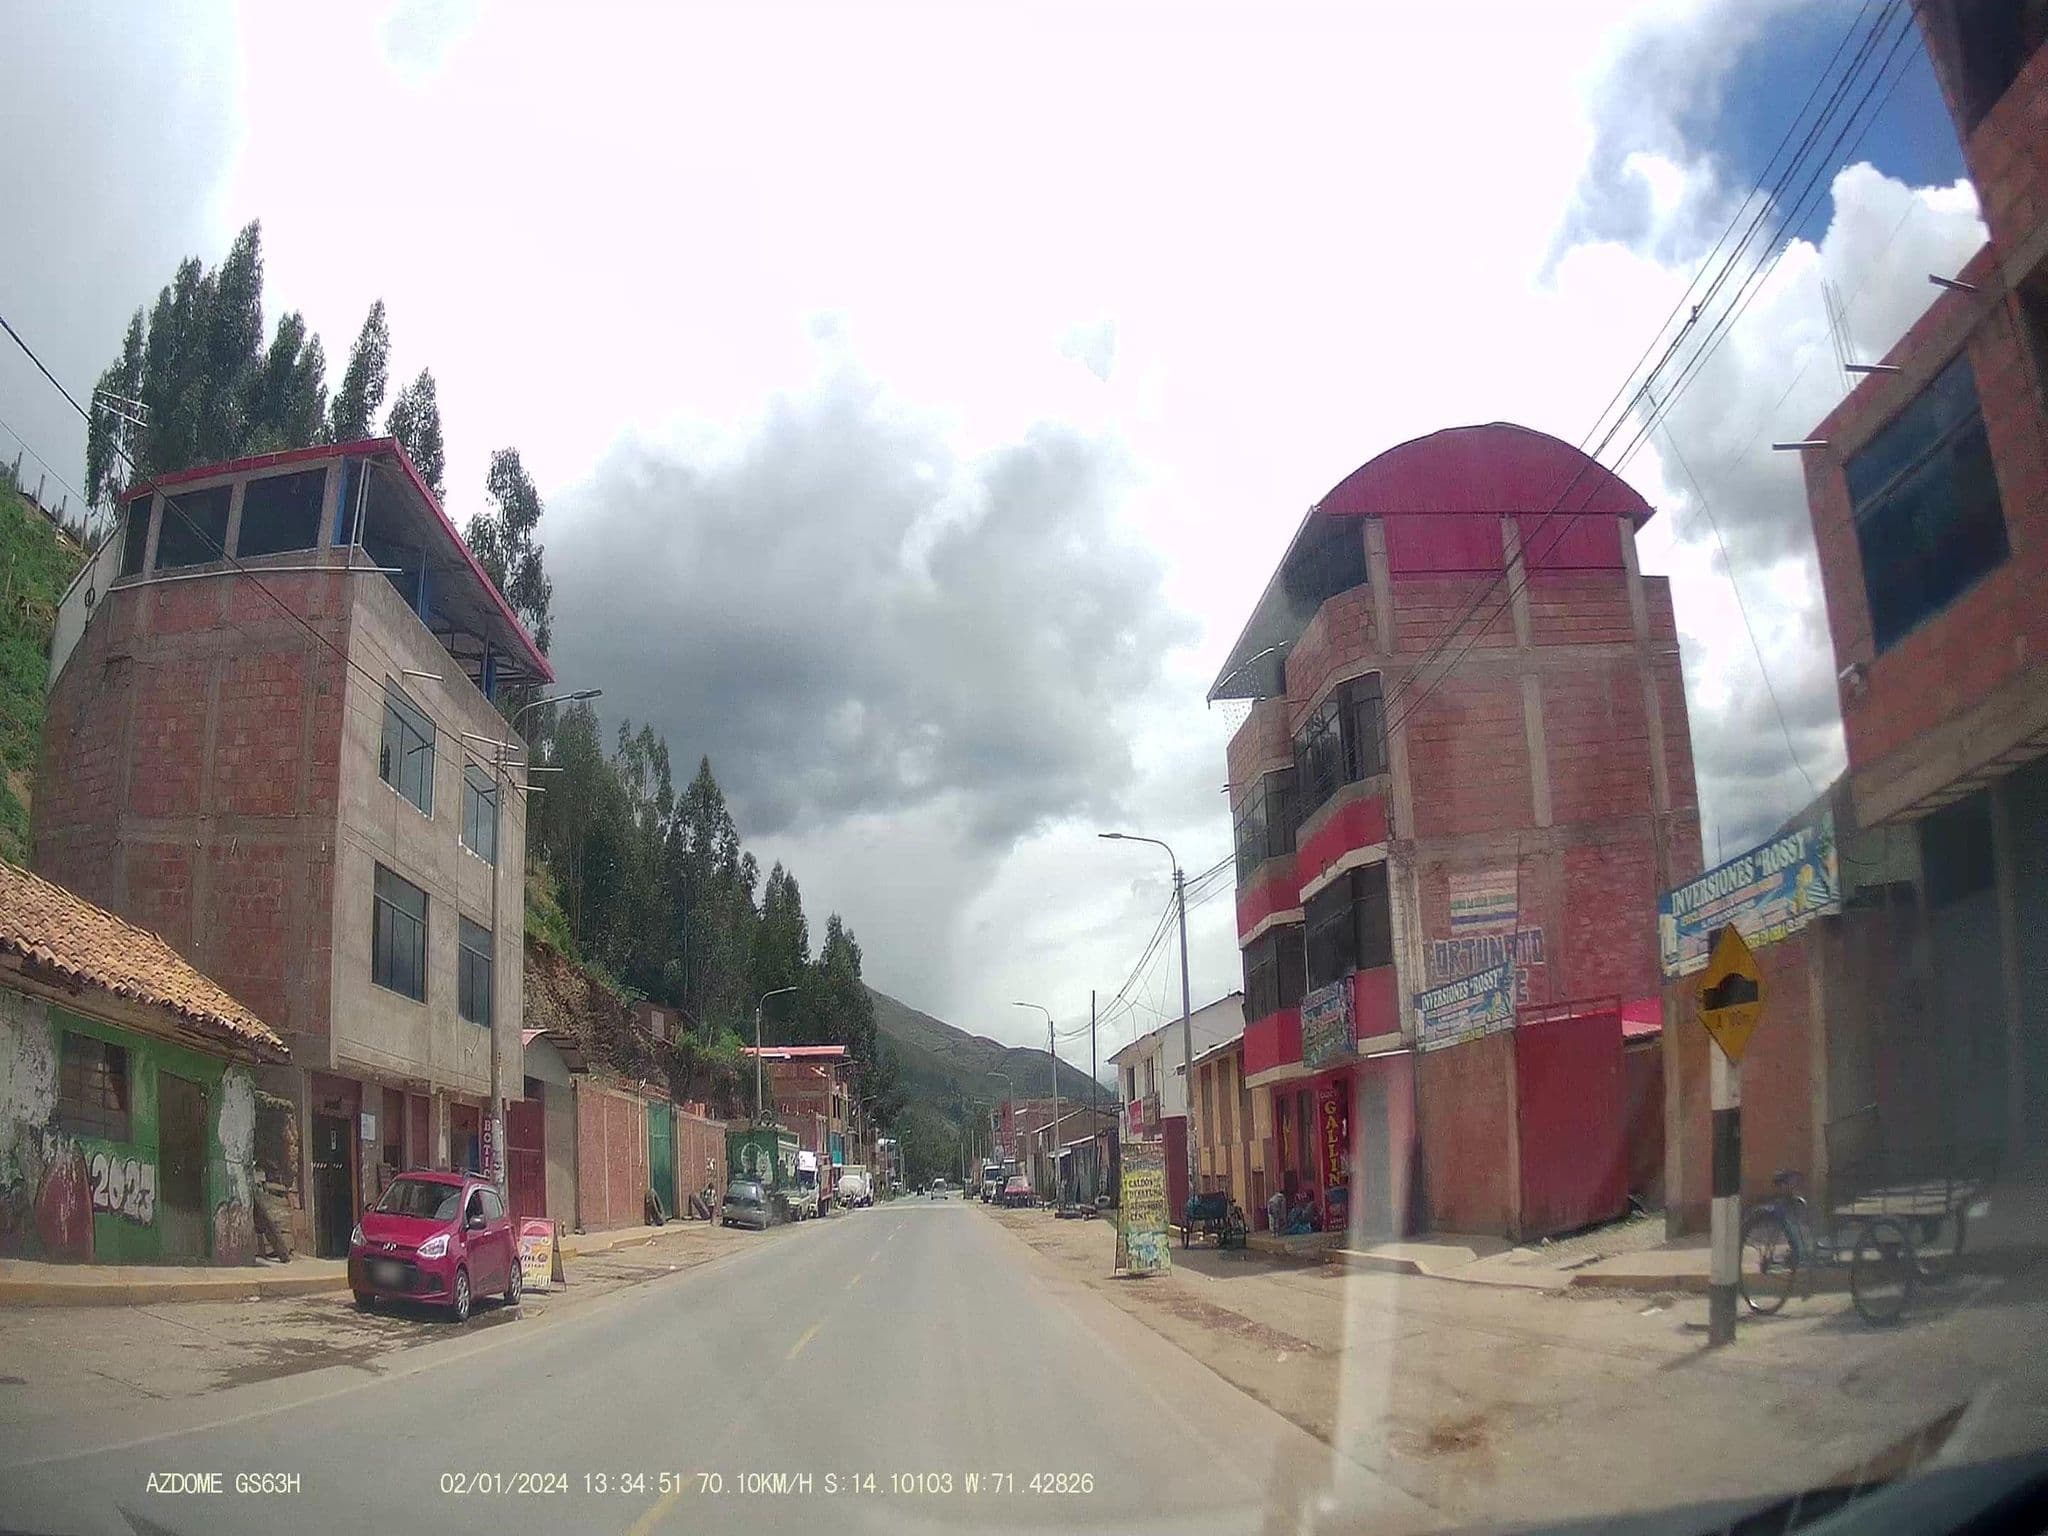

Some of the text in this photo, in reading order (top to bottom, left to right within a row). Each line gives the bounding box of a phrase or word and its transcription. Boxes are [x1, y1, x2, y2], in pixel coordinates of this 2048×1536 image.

[1671, 855, 1755, 917] INVERSIONES
[1421, 979, 1470, 1012] INVERSIONES
[1324, 1101, 1340, 1187] GALLIN
